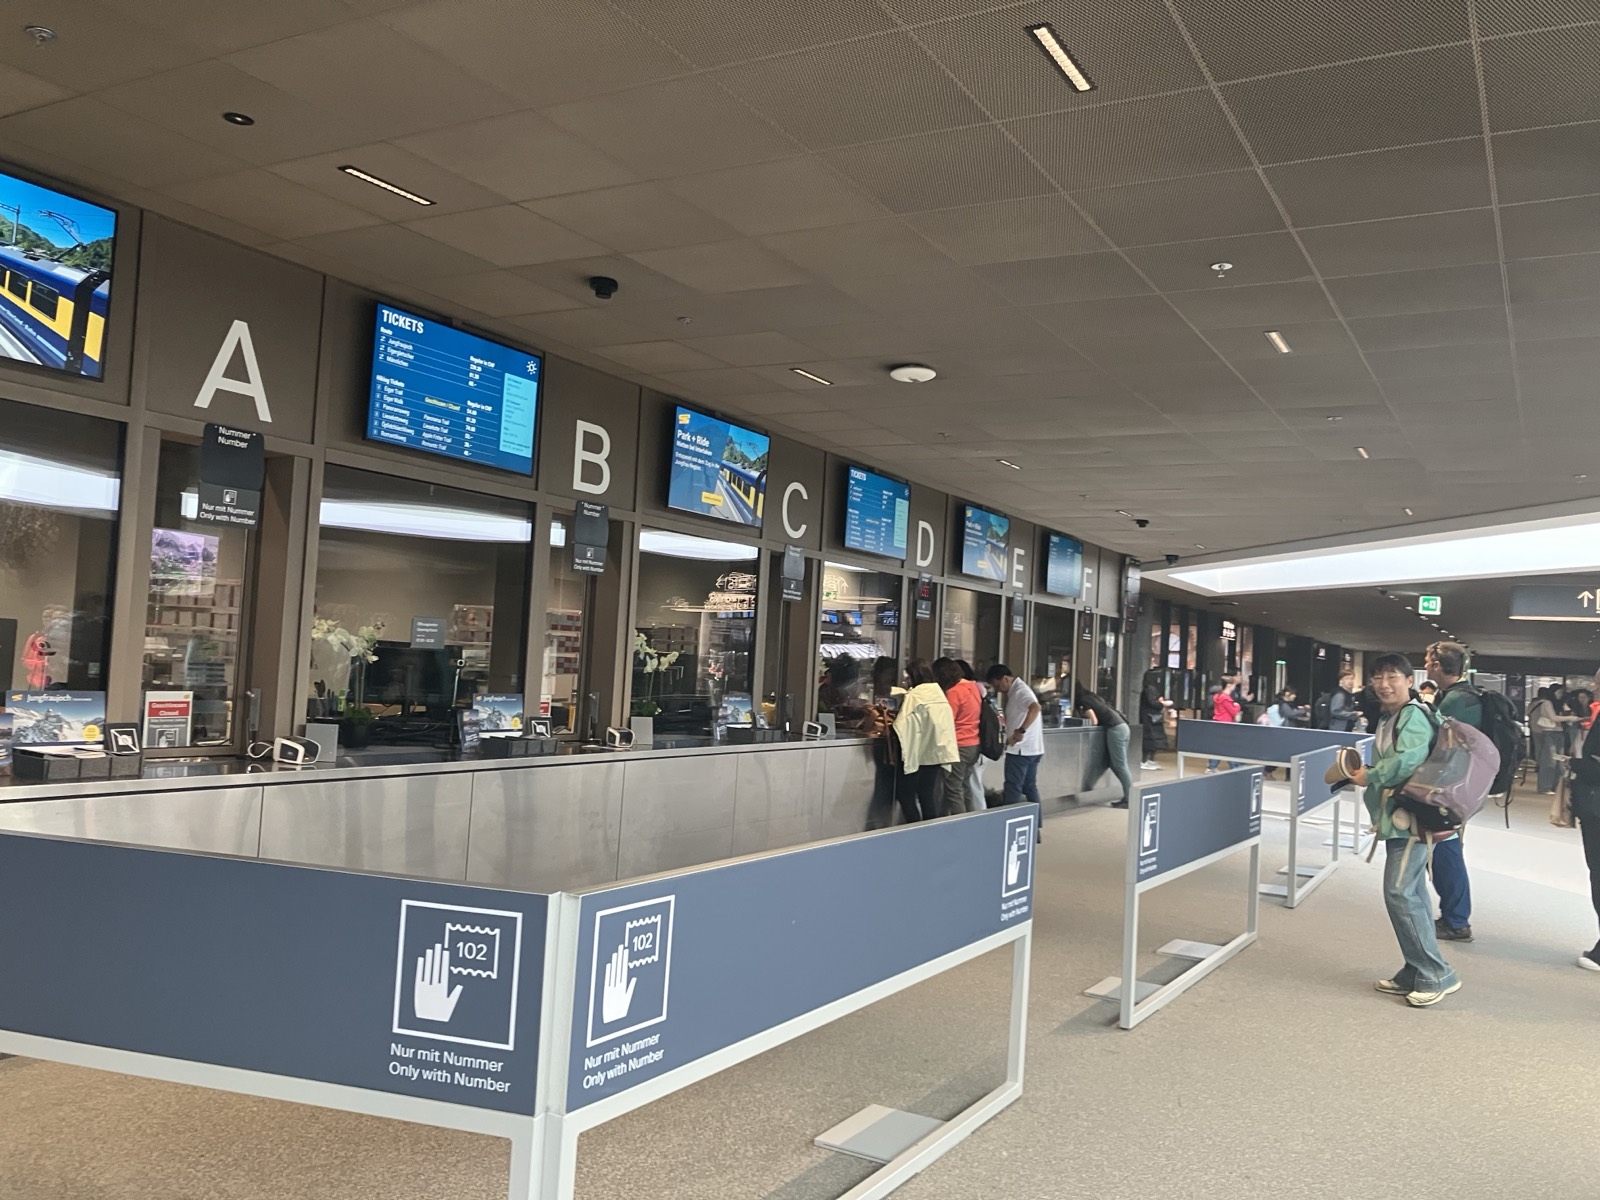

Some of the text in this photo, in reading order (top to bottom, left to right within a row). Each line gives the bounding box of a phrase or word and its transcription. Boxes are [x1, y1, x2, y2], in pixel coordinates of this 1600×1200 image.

[382, 309, 424, 334] TICKETS
[194, 320, 272, 422] A
[218, 436, 248, 448] Number
[219, 426, 251, 440] Nummer
[677, 429, 690, 442] Park
[697, 436, 710, 448] Ride
[573, 420, 611, 495] B
[200, 512, 214, 521] Only
[230, 516, 256, 525] Number
[202, 502, 214, 511] Nur
[227, 506, 255, 516] Nummer
[782, 482, 808, 538] C
[916, 520, 934, 567] D
[1012, 548, 1025, 588] E
[1082, 567, 1093, 601] F
[456, 941, 488, 960] 102
[632, 932, 653, 952] 102
[390, 1042, 504, 1072] Nur mit Nummer
[584, 1033, 660, 1071] Nur mit Nummer
[388, 1062, 511, 1093] Only with Number
[582, 1048, 664, 1090] Only with Number
